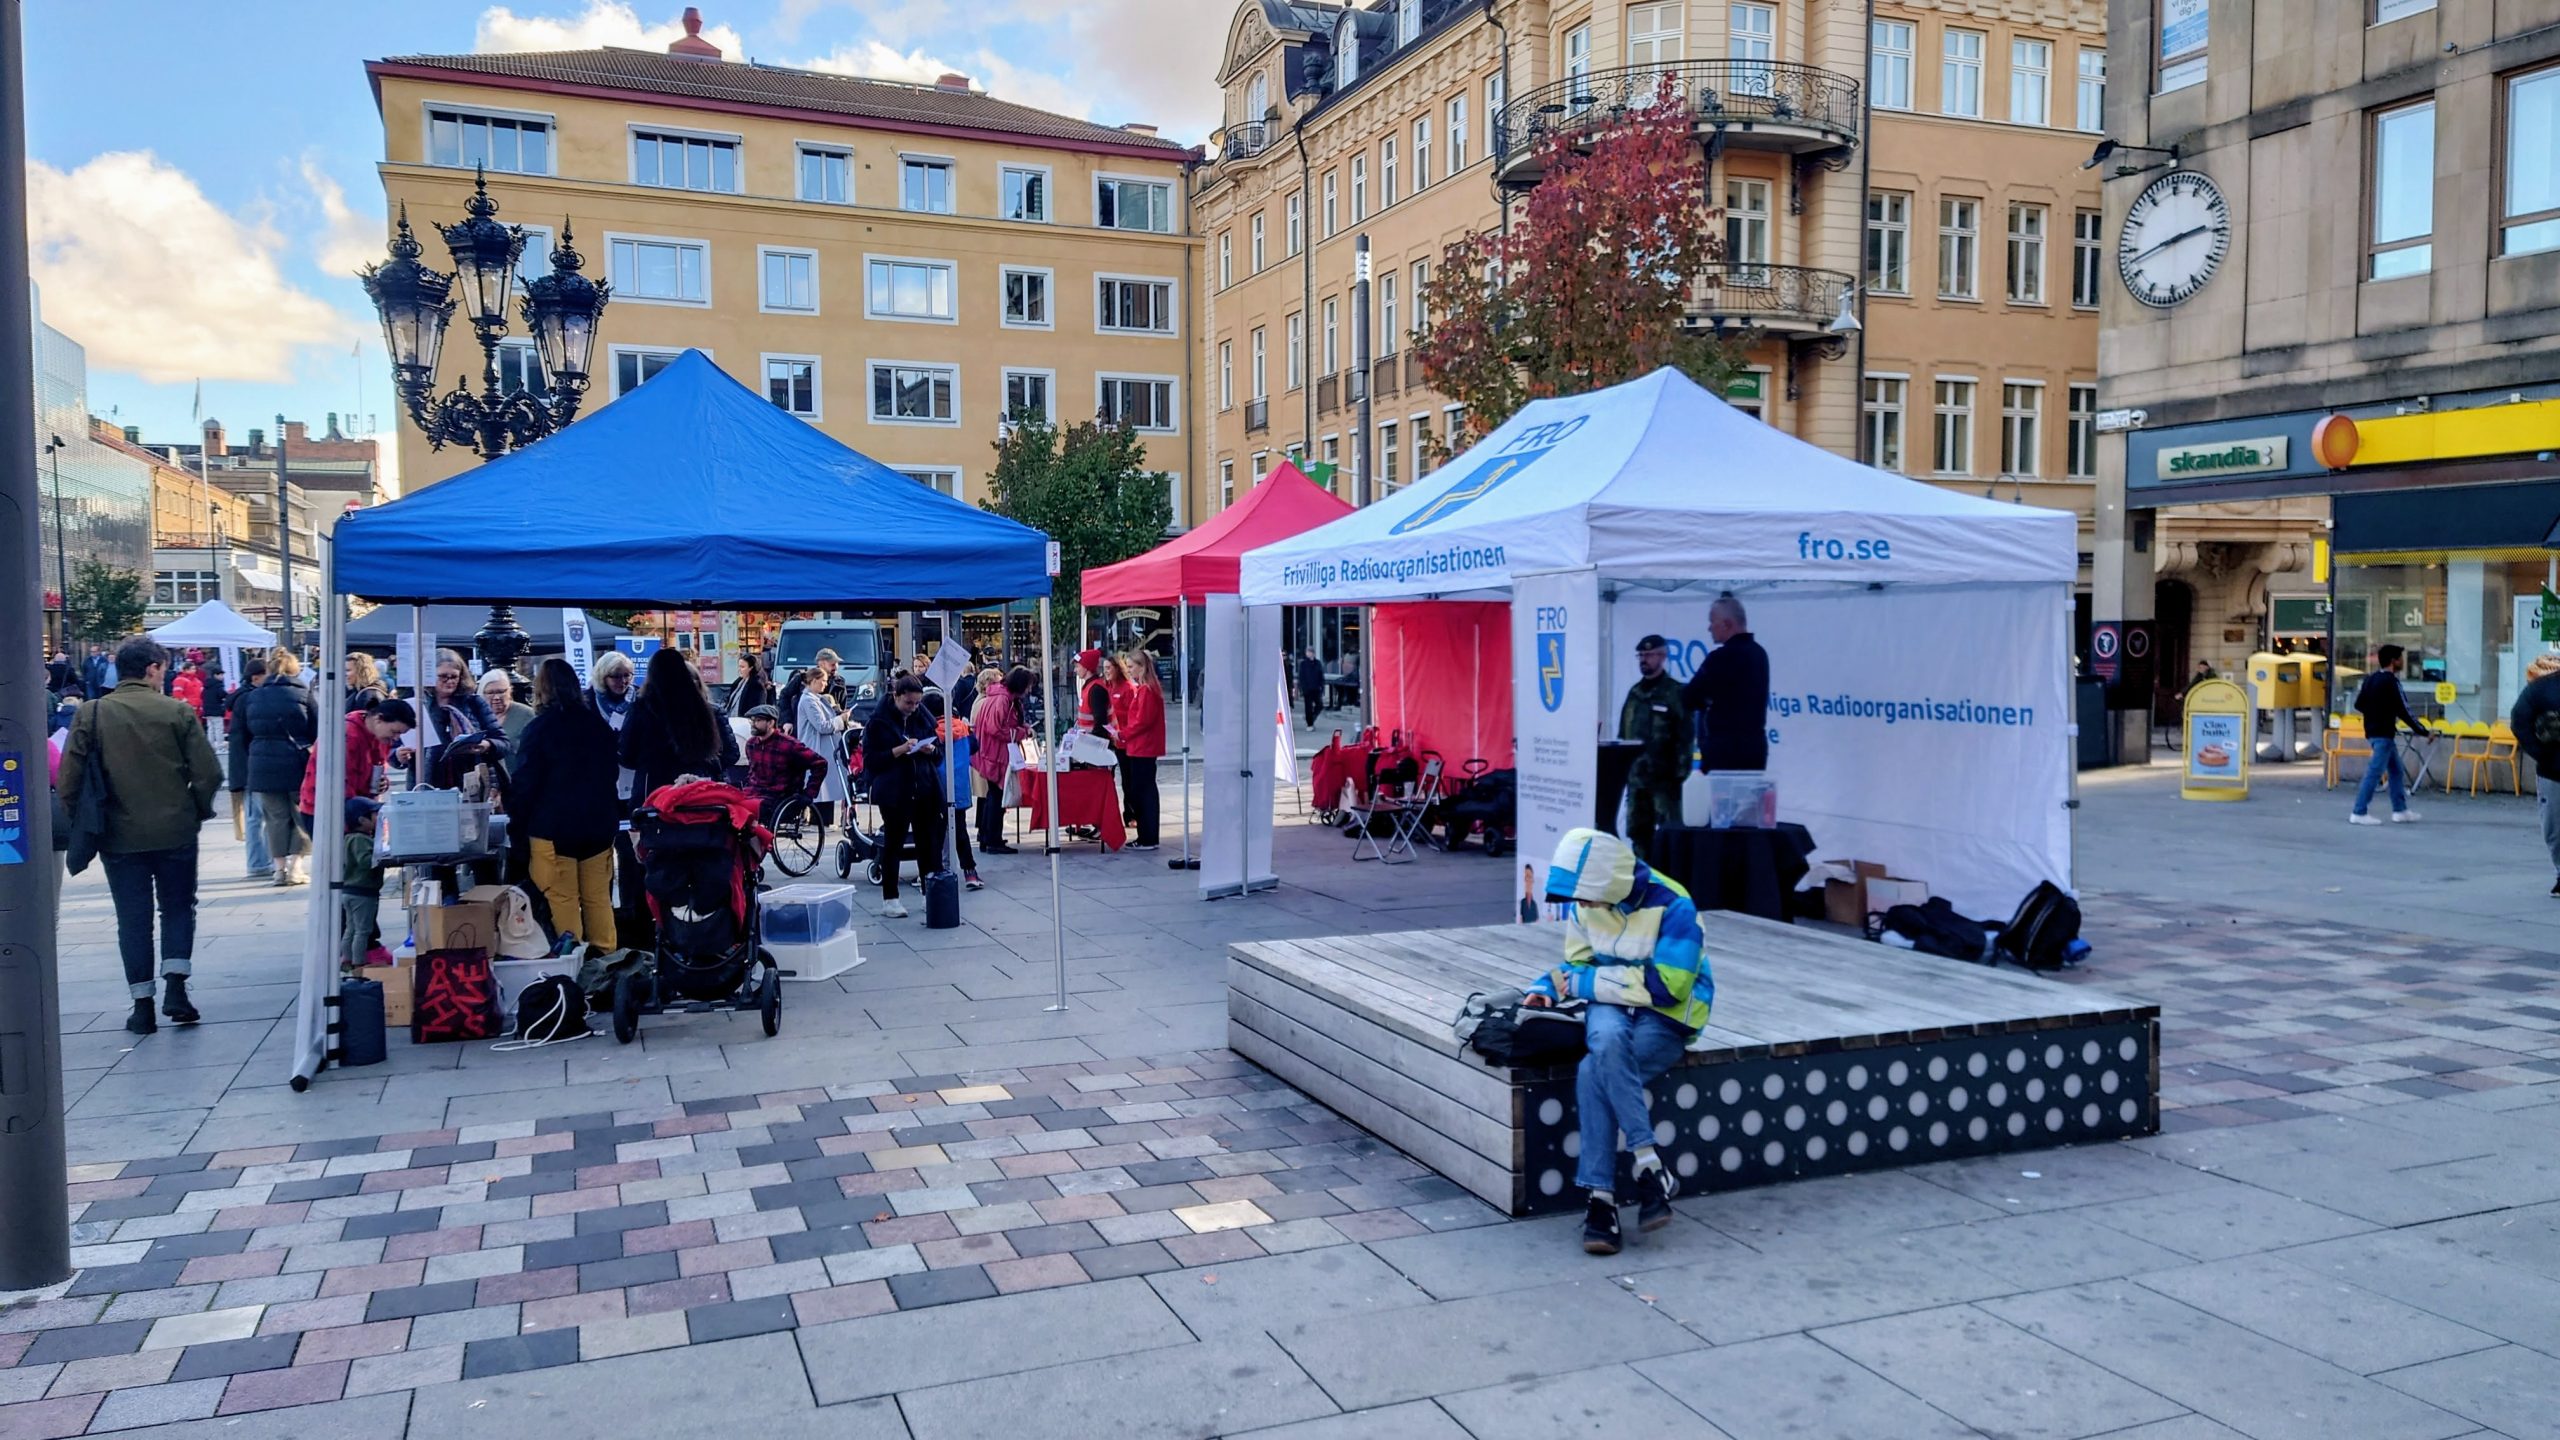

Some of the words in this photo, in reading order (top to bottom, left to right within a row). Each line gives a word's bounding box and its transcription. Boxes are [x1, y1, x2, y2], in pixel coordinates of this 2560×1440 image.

[1496, 414, 1591, 455] FRO
[2170, 446, 2259, 472] skandia
[1798, 531, 1891, 560] fro.se
[1284, 561, 1335, 588] Frivilliga
[1341, 545, 1507, 584] Radioorganisationen
[701, 617, 717, 625] 20%
[1536, 606, 1568, 631] FRO
[1666, 638, 1709, 678] RO
[1807, 694, 2034, 727] Radioorganisationen
